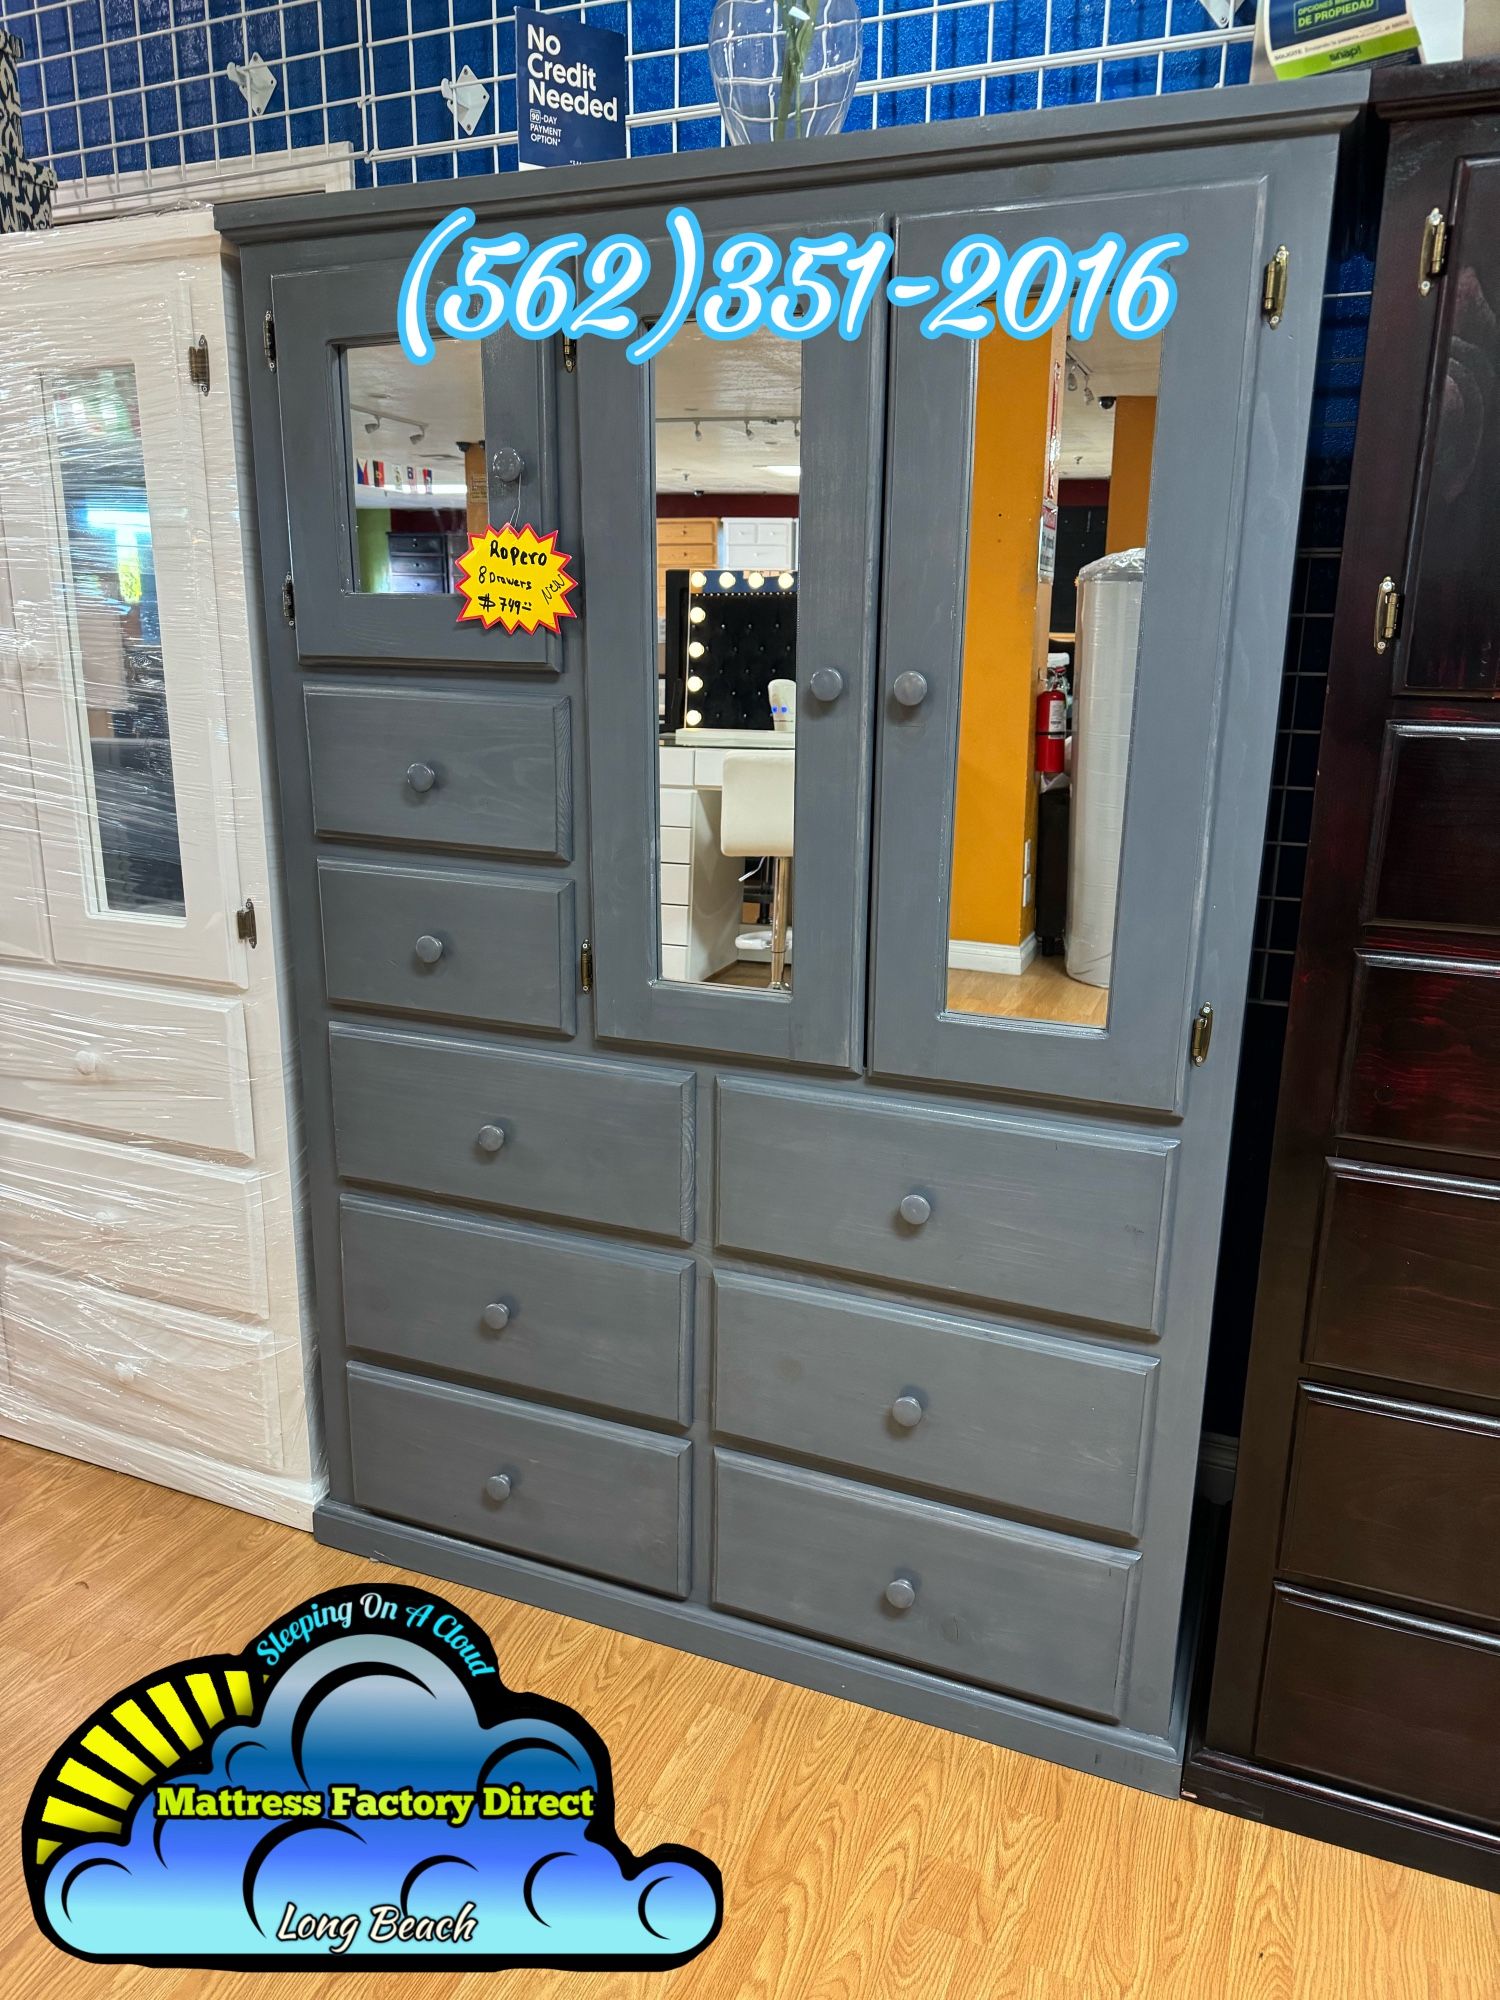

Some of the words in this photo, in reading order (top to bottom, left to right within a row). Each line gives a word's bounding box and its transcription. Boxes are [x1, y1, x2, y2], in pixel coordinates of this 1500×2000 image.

[1297, 17, 1312, 27] DE
[1314, 0, 1374, 23] PROPIEDAD
[527, 24, 561, 55] No
[527, 52, 597, 91] Credit
[528, 79, 618, 122] Needed
[530, 123, 562, 137] PAYMENT
[489, 539, 548, 566] Ropero
[478, 565, 487, 584] 8
[489, 571, 533, 590] Drawers
